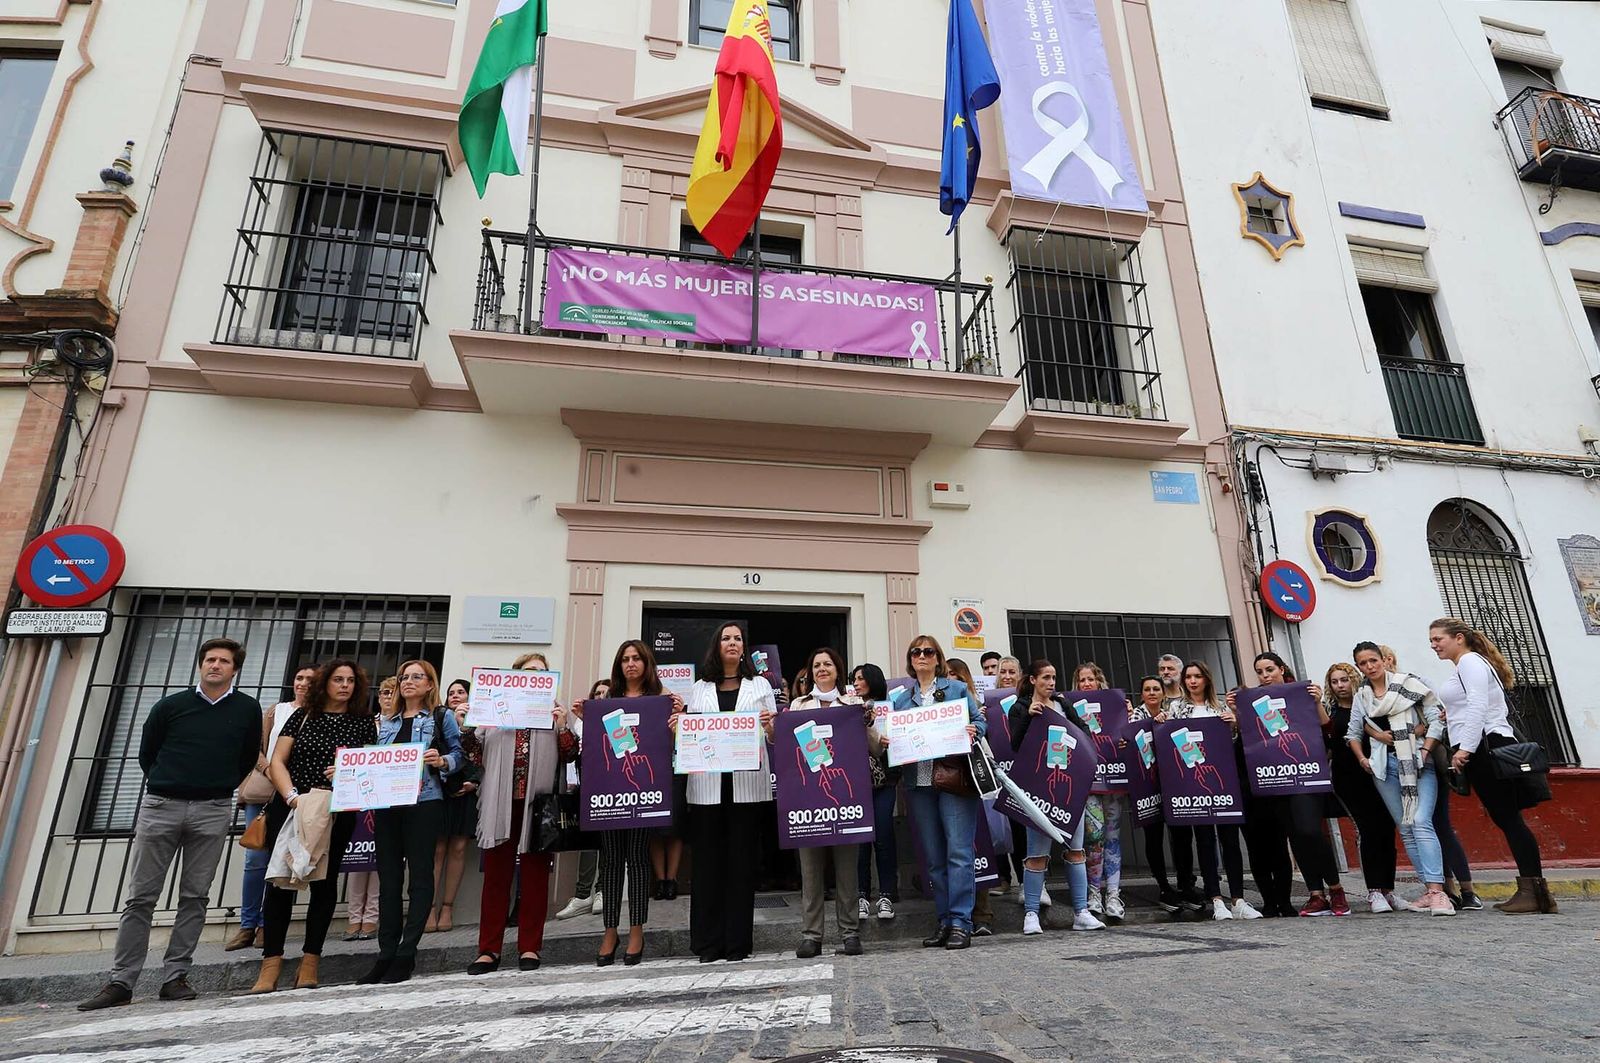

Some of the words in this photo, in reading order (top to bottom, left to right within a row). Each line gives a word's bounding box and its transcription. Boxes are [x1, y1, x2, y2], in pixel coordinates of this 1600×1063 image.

[1030, 32, 1042, 40] la
[1046, 28, 1059, 42] las
[1036, 44, 1050, 76] contra
[1050, 46, 1066, 74] hacia
[562, 265, 608, 282] ¡NO
[616, 268, 667, 288] MÁS
[780, 286, 924, 312] ASESINADAS!
[743, 573, 761, 584] 10
[658, 668, 675, 678] 200
[676, 668, 690, 677] 999
[478, 674, 502, 686] 900
[504, 675, 527, 688] 200
[530, 676, 553, 689] 999
[892, 714, 913, 726] 900
[916, 709, 938, 722] 200
[940, 704, 962, 717] 999
[682, 719, 705, 731] 900
[707, 718, 730, 730] 200
[732, 717, 755, 730] 999
[342, 752, 366, 767] 900
[368, 750, 392, 764] 200
[394, 749, 418, 763] 999
[1107, 762, 1126, 774] 999
[1256, 766, 1276, 778] 900
[1277, 764, 1298, 776] 200
[1298, 762, 1320, 774] 999
[590, 794, 613, 808] 900
[615, 792, 638, 806] 200
[640, 791, 662, 805] 999
[1137, 797, 1150, 810] 900
[1171, 796, 1191, 808] 900
[1192, 796, 1212, 807] 200
[1213, 794, 1234, 806] 999
[788, 809, 812, 824] 900
[814, 807, 838, 823] 200
[840, 805, 863, 820] 999
[1050, 806, 1072, 824] 999
[354, 841, 375, 853] 200
[974, 857, 988, 870] 99
